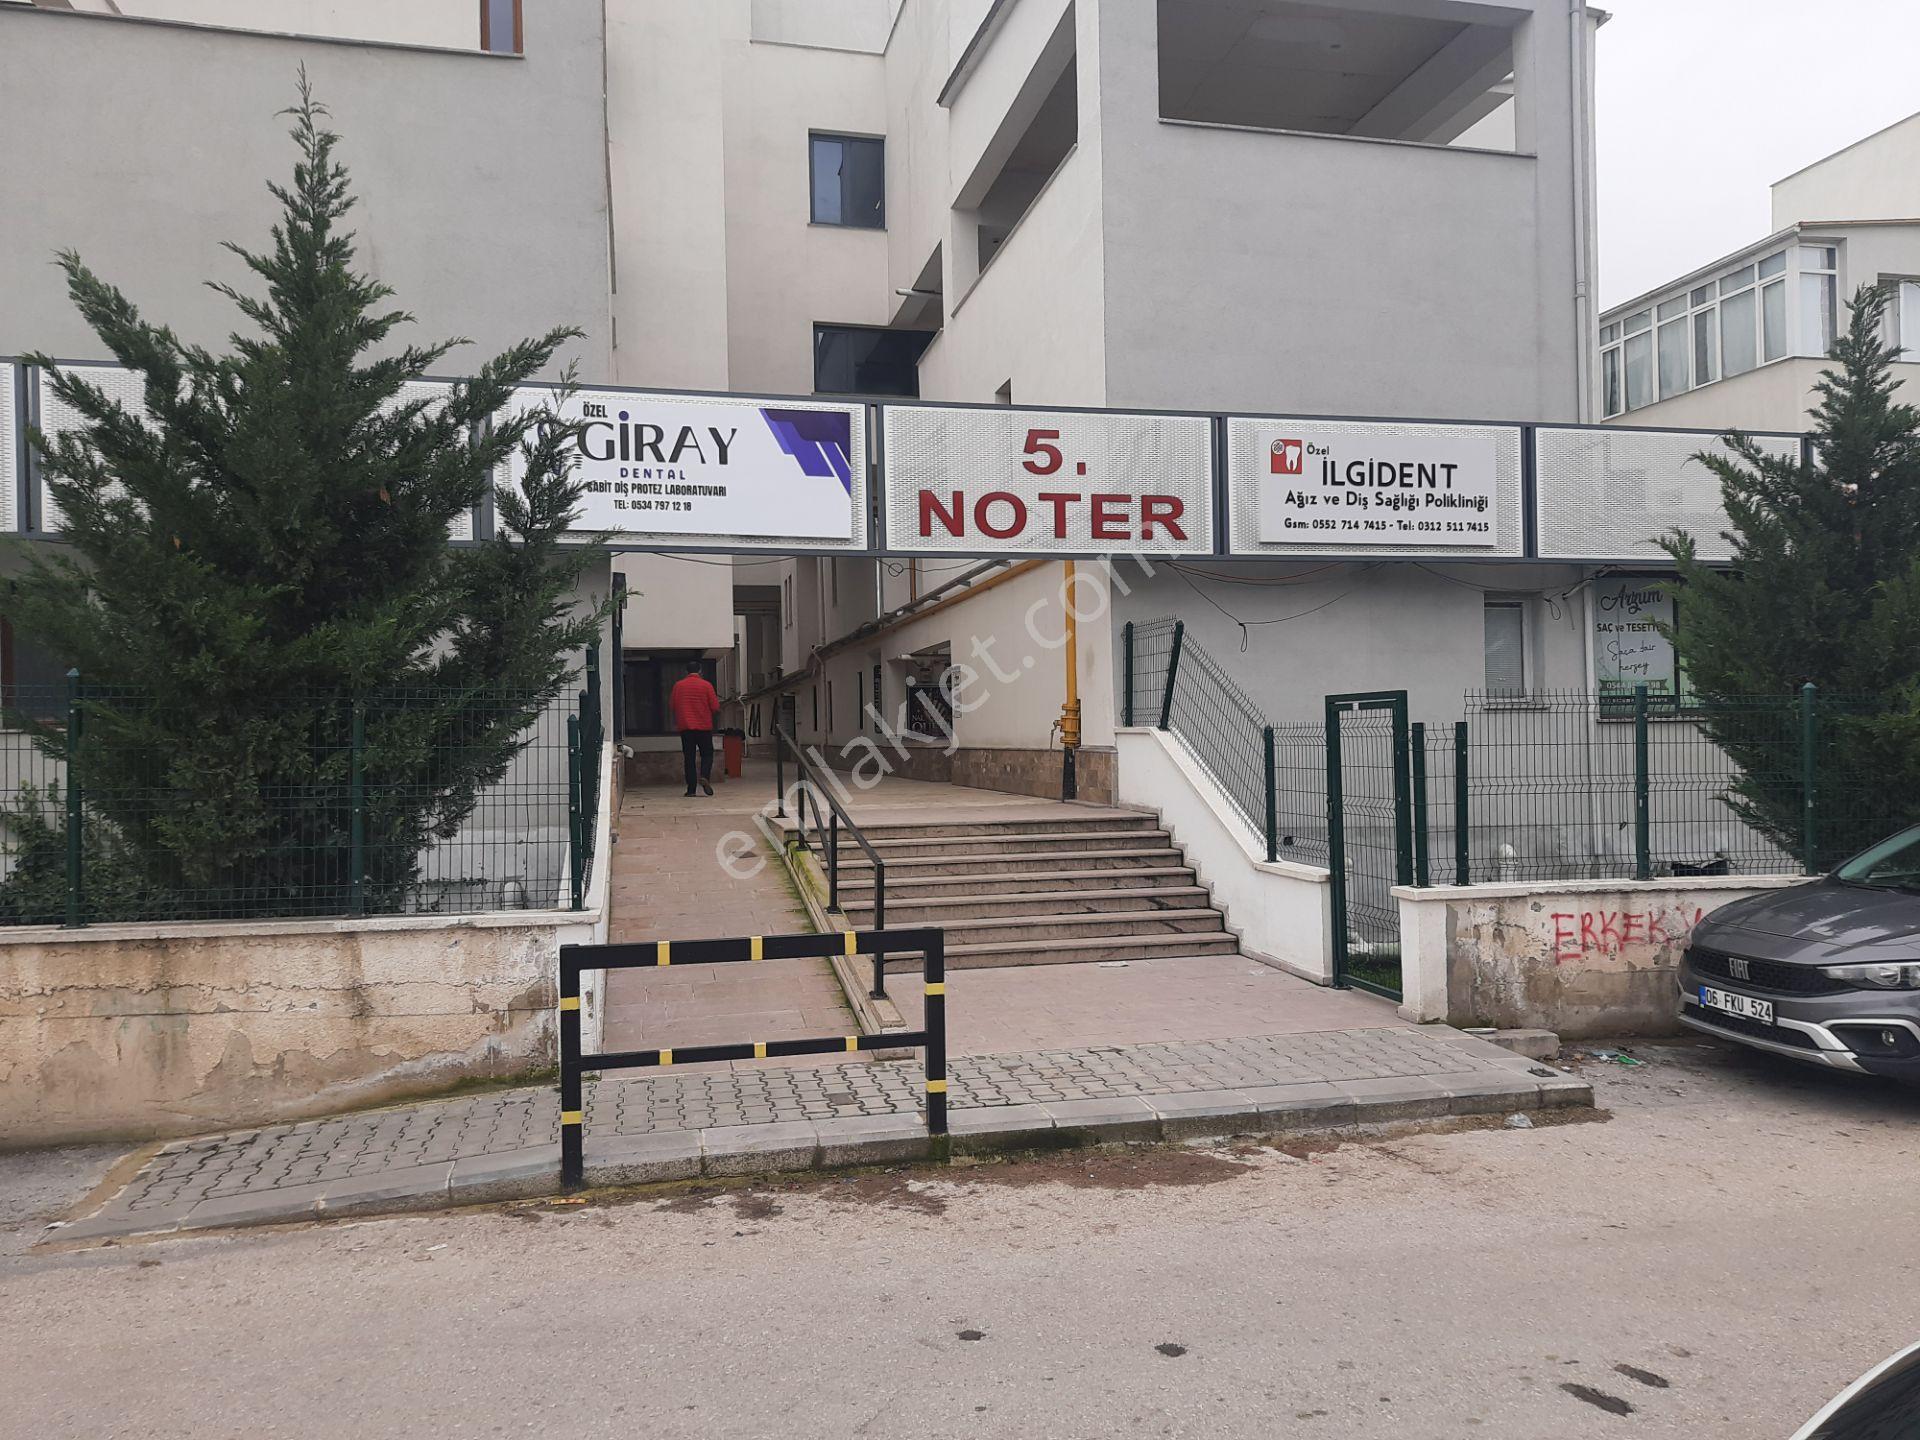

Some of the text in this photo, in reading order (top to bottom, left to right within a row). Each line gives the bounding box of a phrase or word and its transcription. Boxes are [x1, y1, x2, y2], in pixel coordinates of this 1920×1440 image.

[583, 401, 608, 418] ÖZEL
[577, 410, 737, 465] GİRAY
[1022, 428, 1087, 476] 5.
[1307, 442, 1330, 455] Özel
[620, 467, 686, 480] DENTAL
[1322, 457, 1458, 488] İLGİDENT
[587, 480, 727, 497] SABİT DİŞ PROTEZ LABORATUVARI
[613, 500, 692, 511] TEL: 0534 797 12 18
[1285, 490, 1489, 512] Ağız ve Diş Sağlığı Polikliniği
[918, 489, 1188, 540] NOTER
[1284, 517, 1309, 529] Gsm:
[1312, 519, 1337, 530] 0552
[1341, 520, 1360, 530] 714
[1364, 520, 1387, 531] 7415
[1397, 520, 1415, 531] Tel:
[1417, 521, 1442, 531] 0312
[1446, 522, 1465, 532] 511
[1466, 522, 1489, 532] 7415
[1596, 622, 1613, 634] SAÇ
[1729, 957, 1749, 980] FIAT
[1706, 989, 1718, 1006] 06
[1724, 994, 1744, 1012] FKU
[1751, 1000, 1771, 1019] 524
